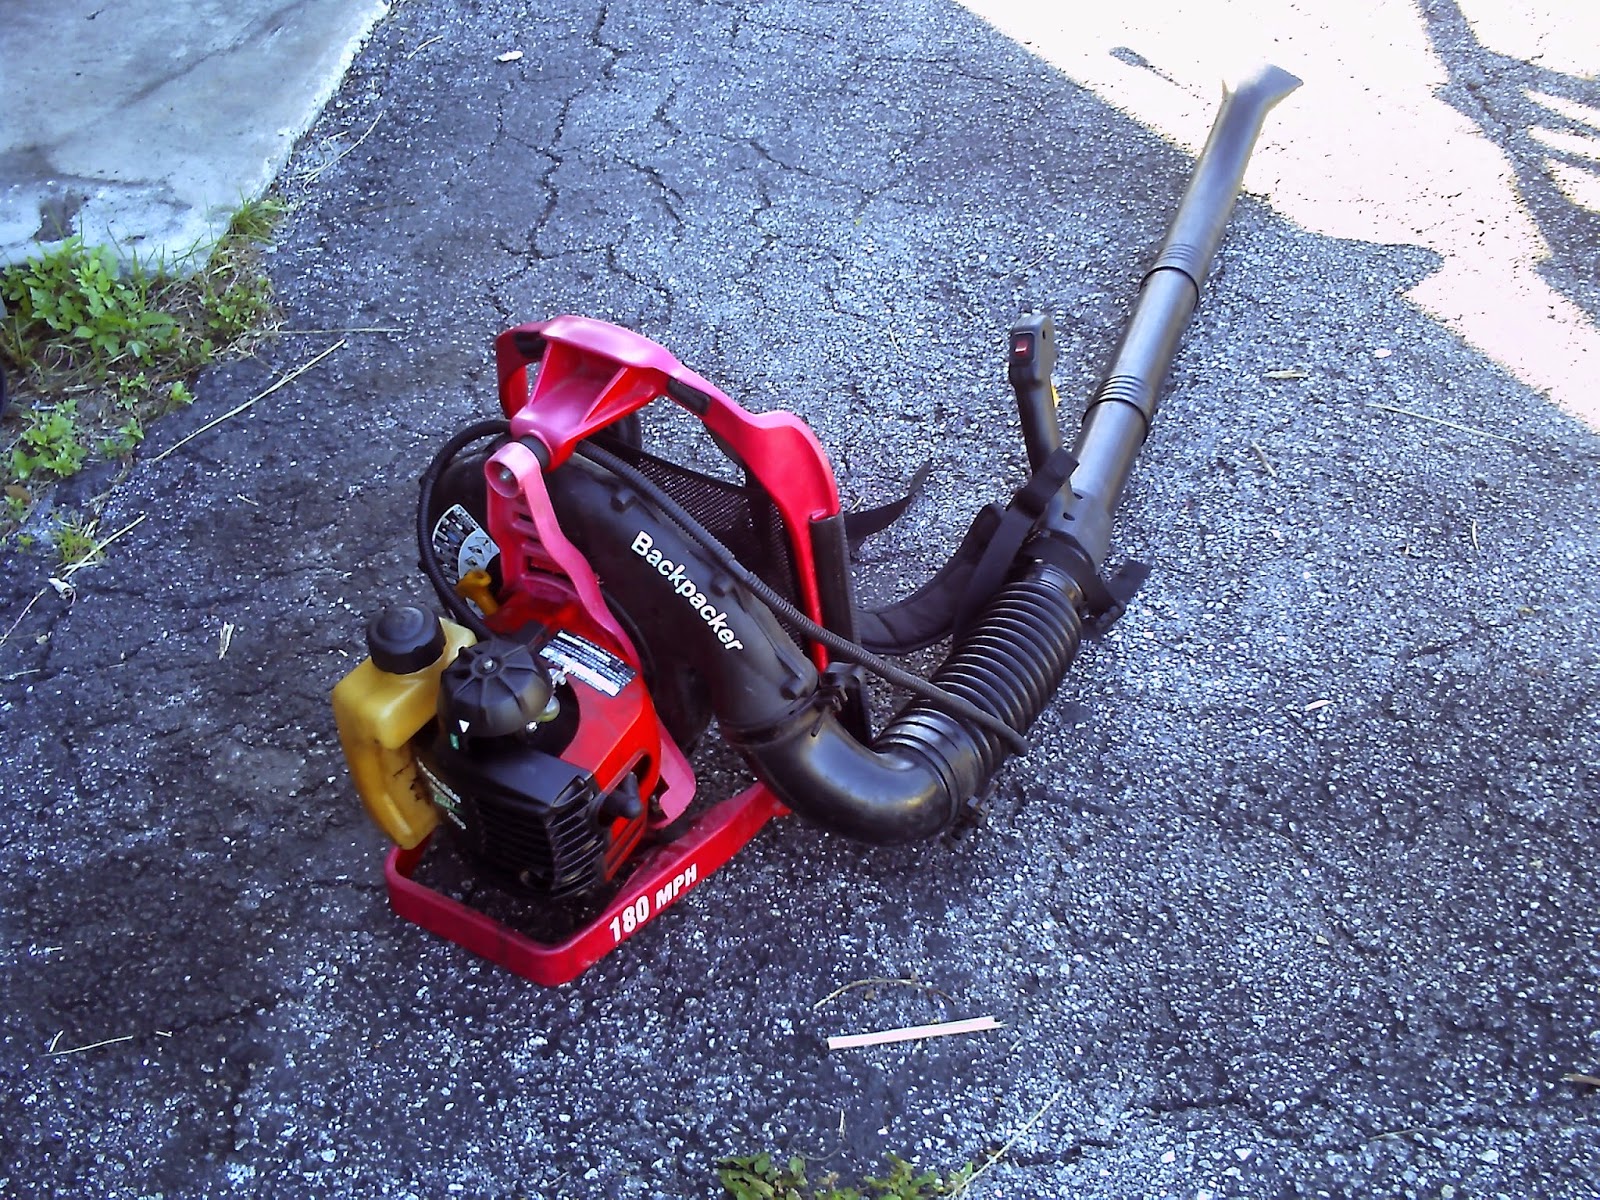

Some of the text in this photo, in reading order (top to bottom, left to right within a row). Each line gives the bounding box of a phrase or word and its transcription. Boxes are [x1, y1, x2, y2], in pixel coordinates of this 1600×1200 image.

[631, 530, 743, 650] Backpacker
[609, 863, 697, 942] 180 MPH
